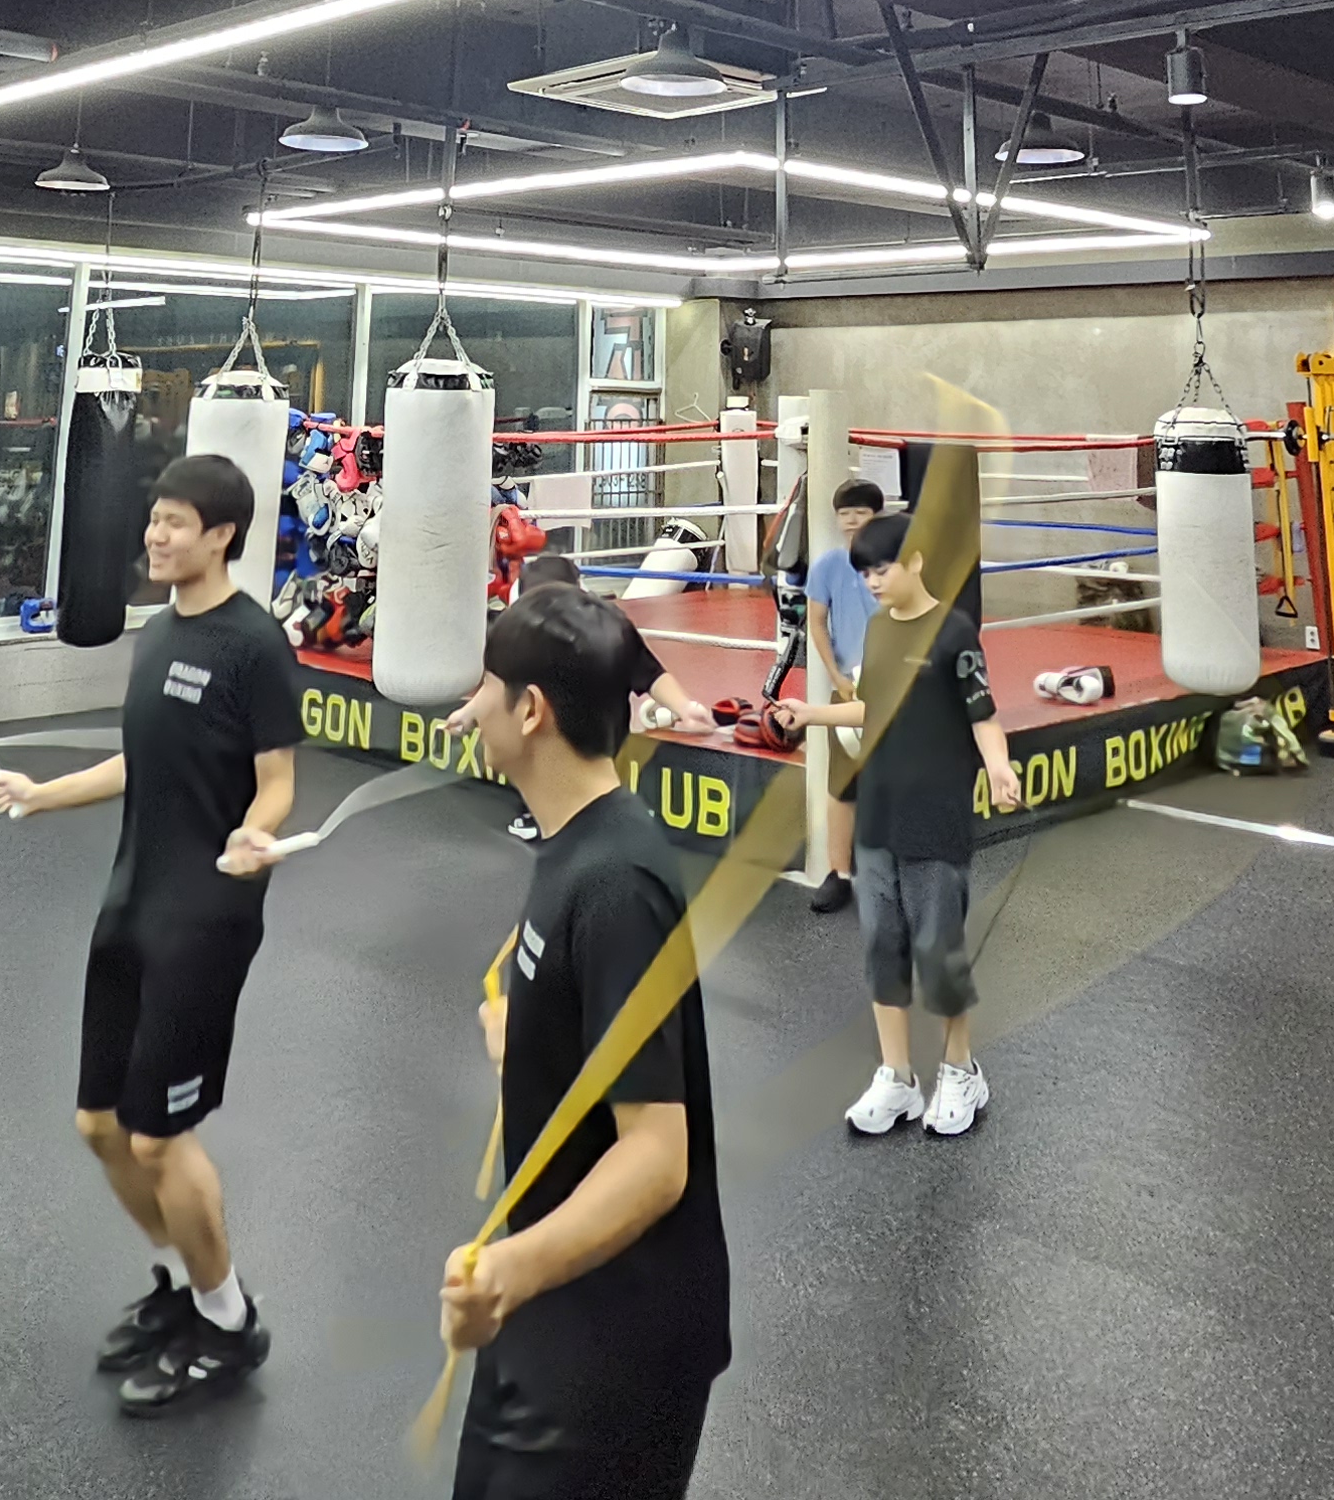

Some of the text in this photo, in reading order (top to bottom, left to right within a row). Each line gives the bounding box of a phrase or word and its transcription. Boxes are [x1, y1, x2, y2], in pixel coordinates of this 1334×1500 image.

[300, 687, 373, 750] GON
[400, 710, 509, 786] BOX
[1105, 710, 1214, 789] BOXING
